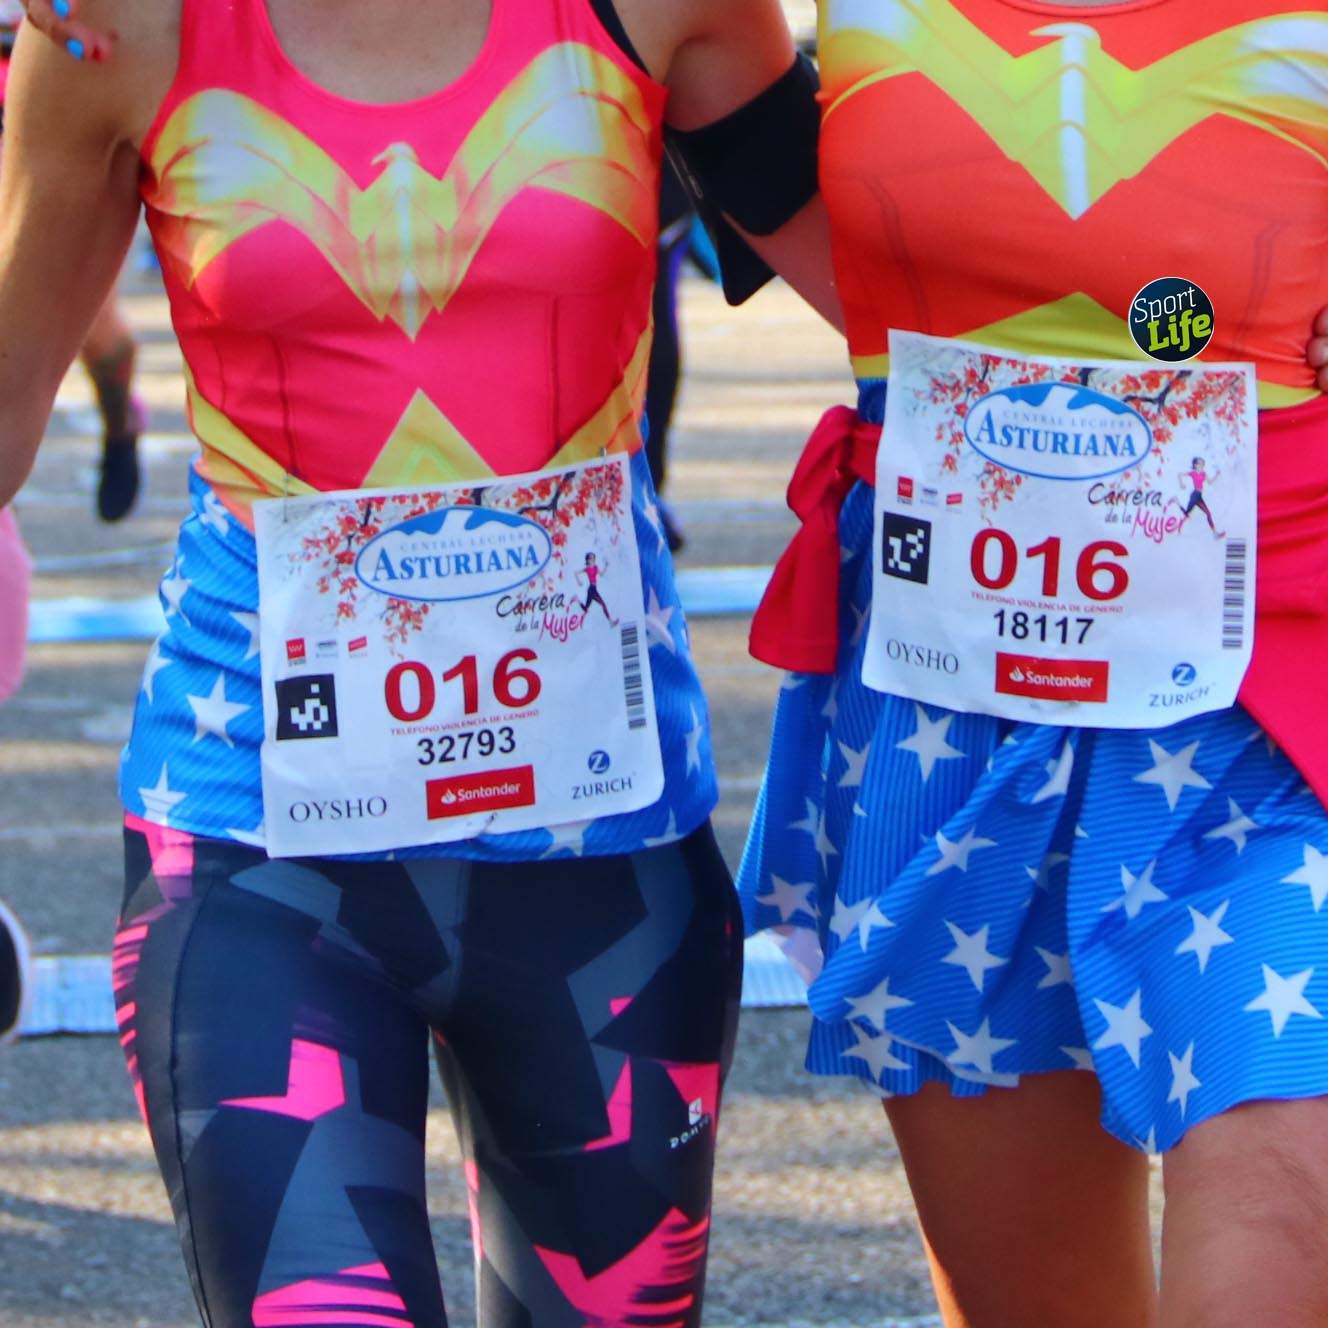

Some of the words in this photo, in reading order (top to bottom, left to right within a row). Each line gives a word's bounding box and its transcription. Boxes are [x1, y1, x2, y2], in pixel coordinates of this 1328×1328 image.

[1134, 287, 1196, 323] Sport
[1147, 310, 1211, 352] Life
[976, 408, 1137, 456] ASTURIANA
[1088, 483, 1162, 506] Carrera
[1105, 508, 1118, 523] de
[1131, 505, 1185, 544] Mujer
[373, 544, 539, 582] ASTURIANA
[970, 528, 1129, 601] 016
[496, 593, 565, 618] Carrera
[515, 616, 527, 632] de
[539, 607, 588, 642] Mujer
[994, 609, 1094, 644] 18117
[886, 639, 959, 673] OYSHO
[384, 647, 541, 722] 016
[1026, 670, 1093, 688] Santander
[1149, 687, 1209, 707] ZURICH
[418, 726, 516, 765] 32793
[458, 781, 520, 803] Santander
[572, 778, 633, 801] ZURICH
[289, 796, 387, 823] OYSHO
